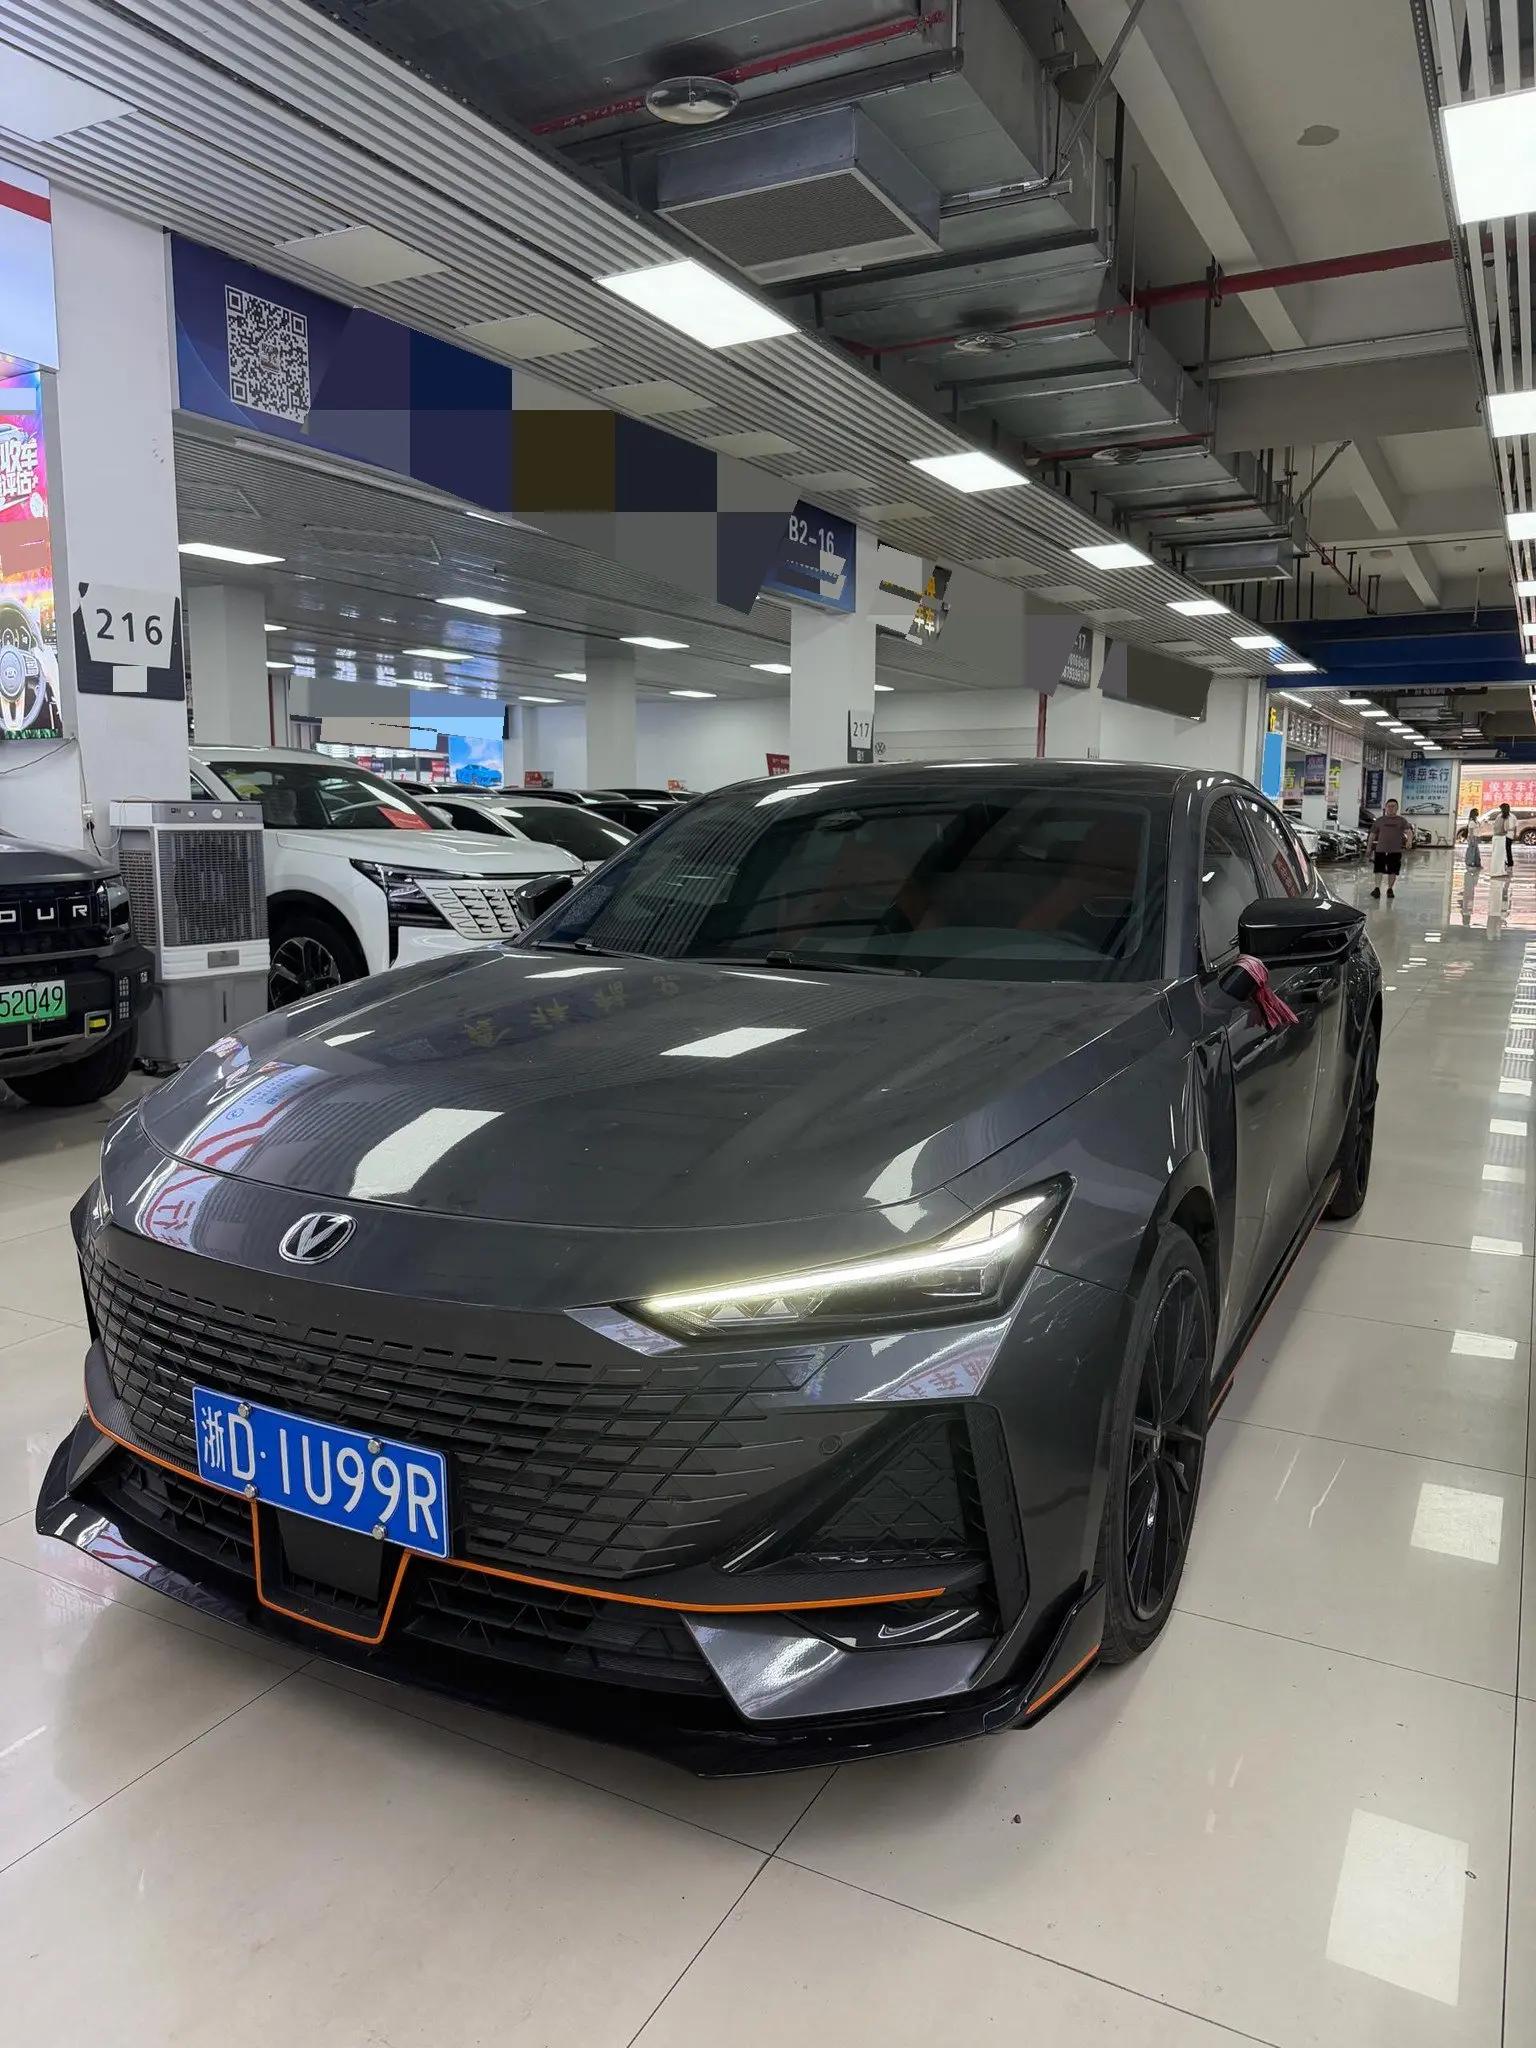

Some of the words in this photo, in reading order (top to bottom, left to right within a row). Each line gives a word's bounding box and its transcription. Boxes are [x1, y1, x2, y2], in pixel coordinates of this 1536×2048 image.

[789, 515, 835, 555] B2-16
[96, 608, 163, 646] 216
[853, 721, 870, 739] 217
